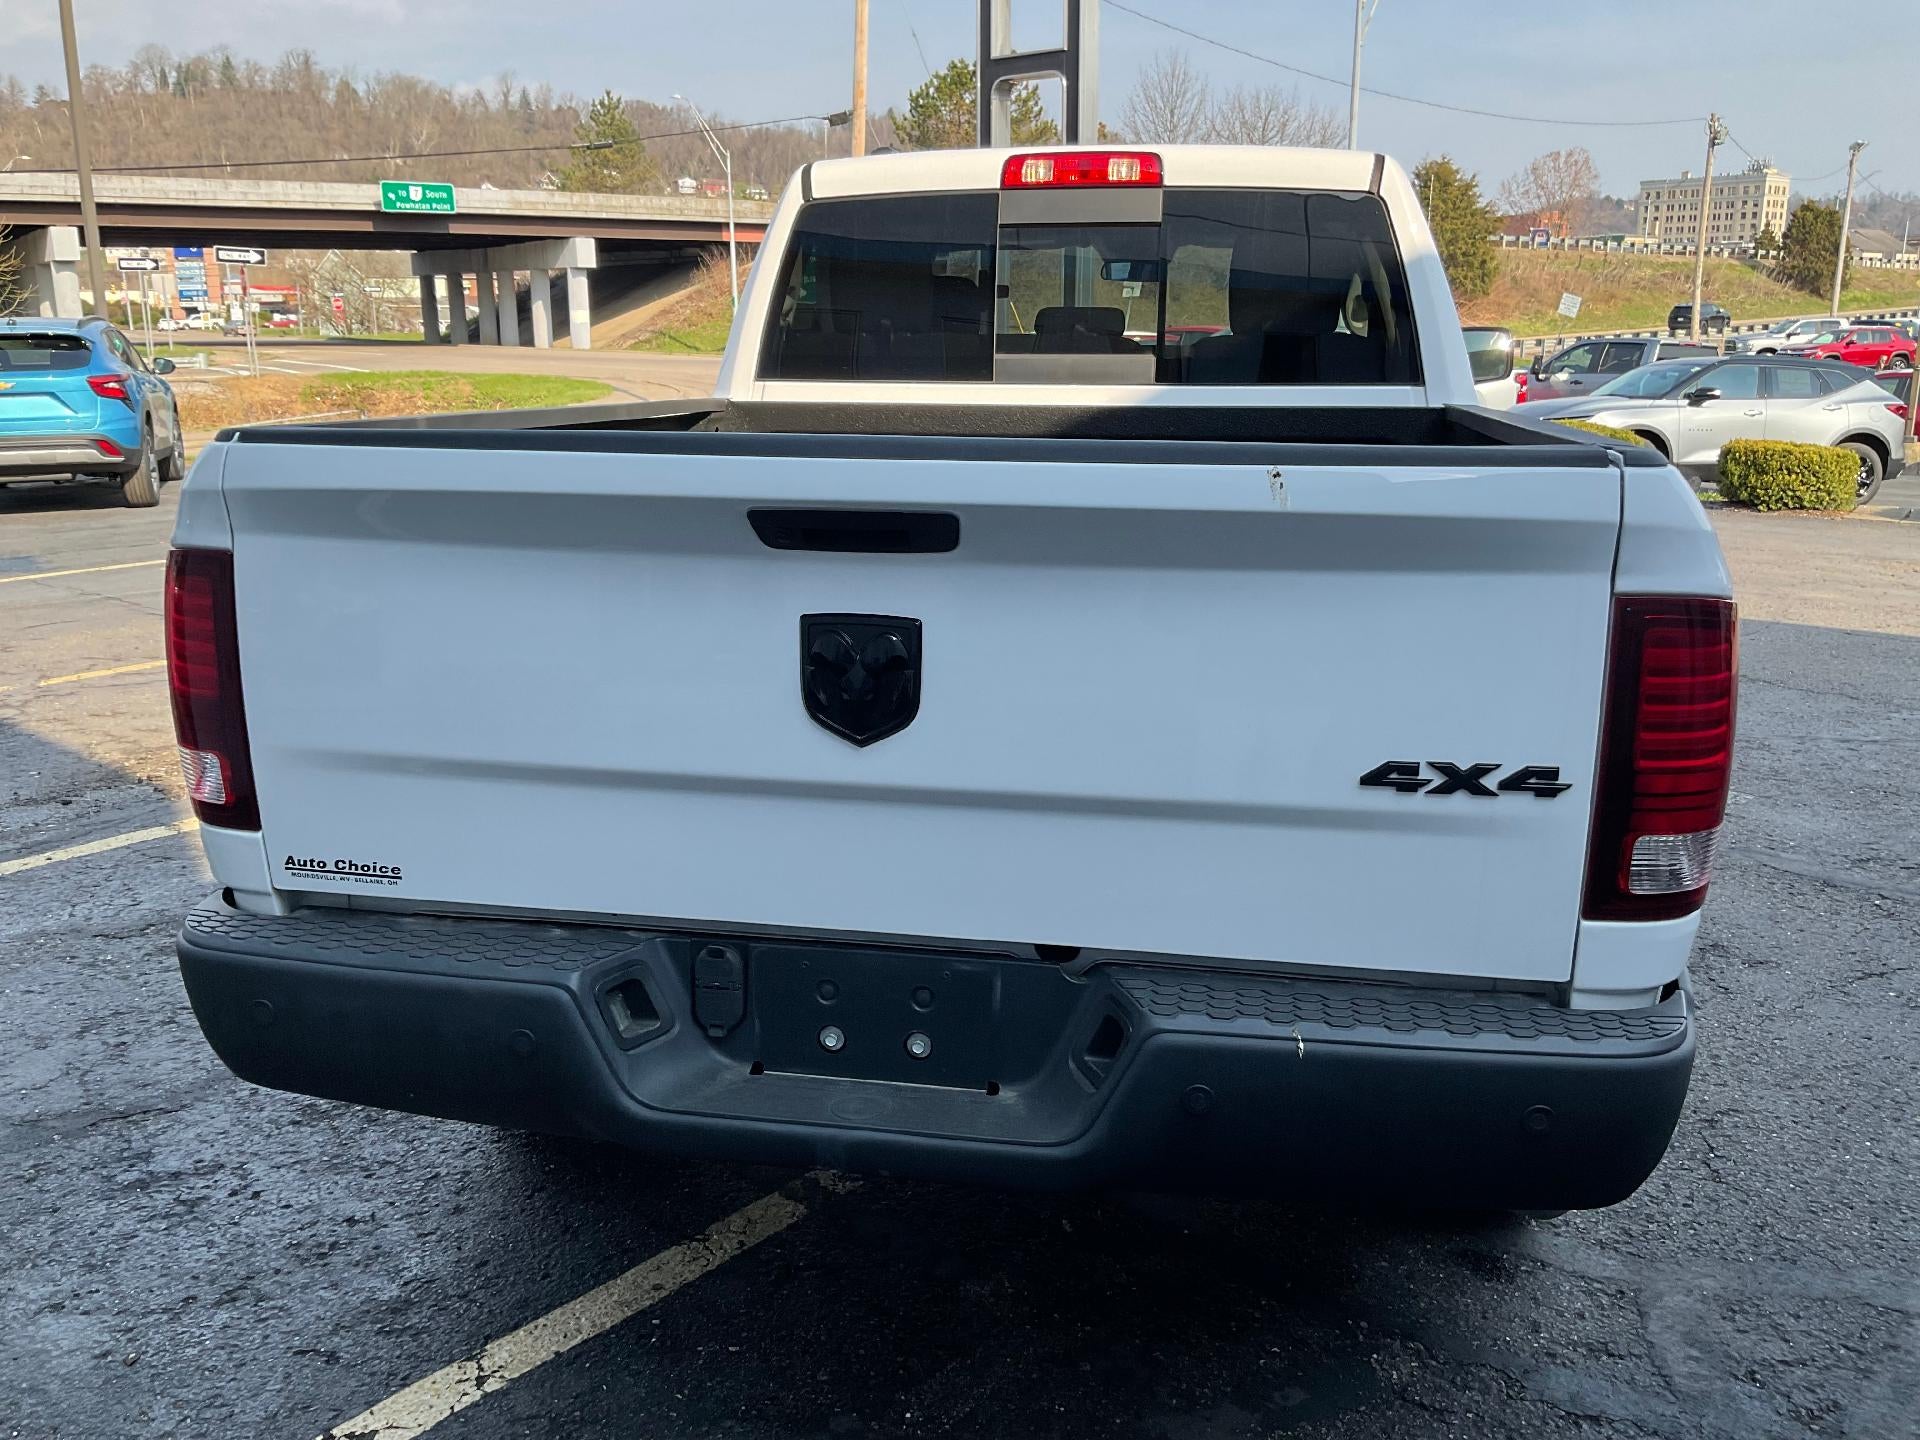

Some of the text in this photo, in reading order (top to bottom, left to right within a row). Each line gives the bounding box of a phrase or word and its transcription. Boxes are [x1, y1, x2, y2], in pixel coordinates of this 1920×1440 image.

[396, 202, 451, 211] Powhatan Point
[1359, 760, 1573, 798] 4X4
[284, 855, 401, 875] Auto Choice
